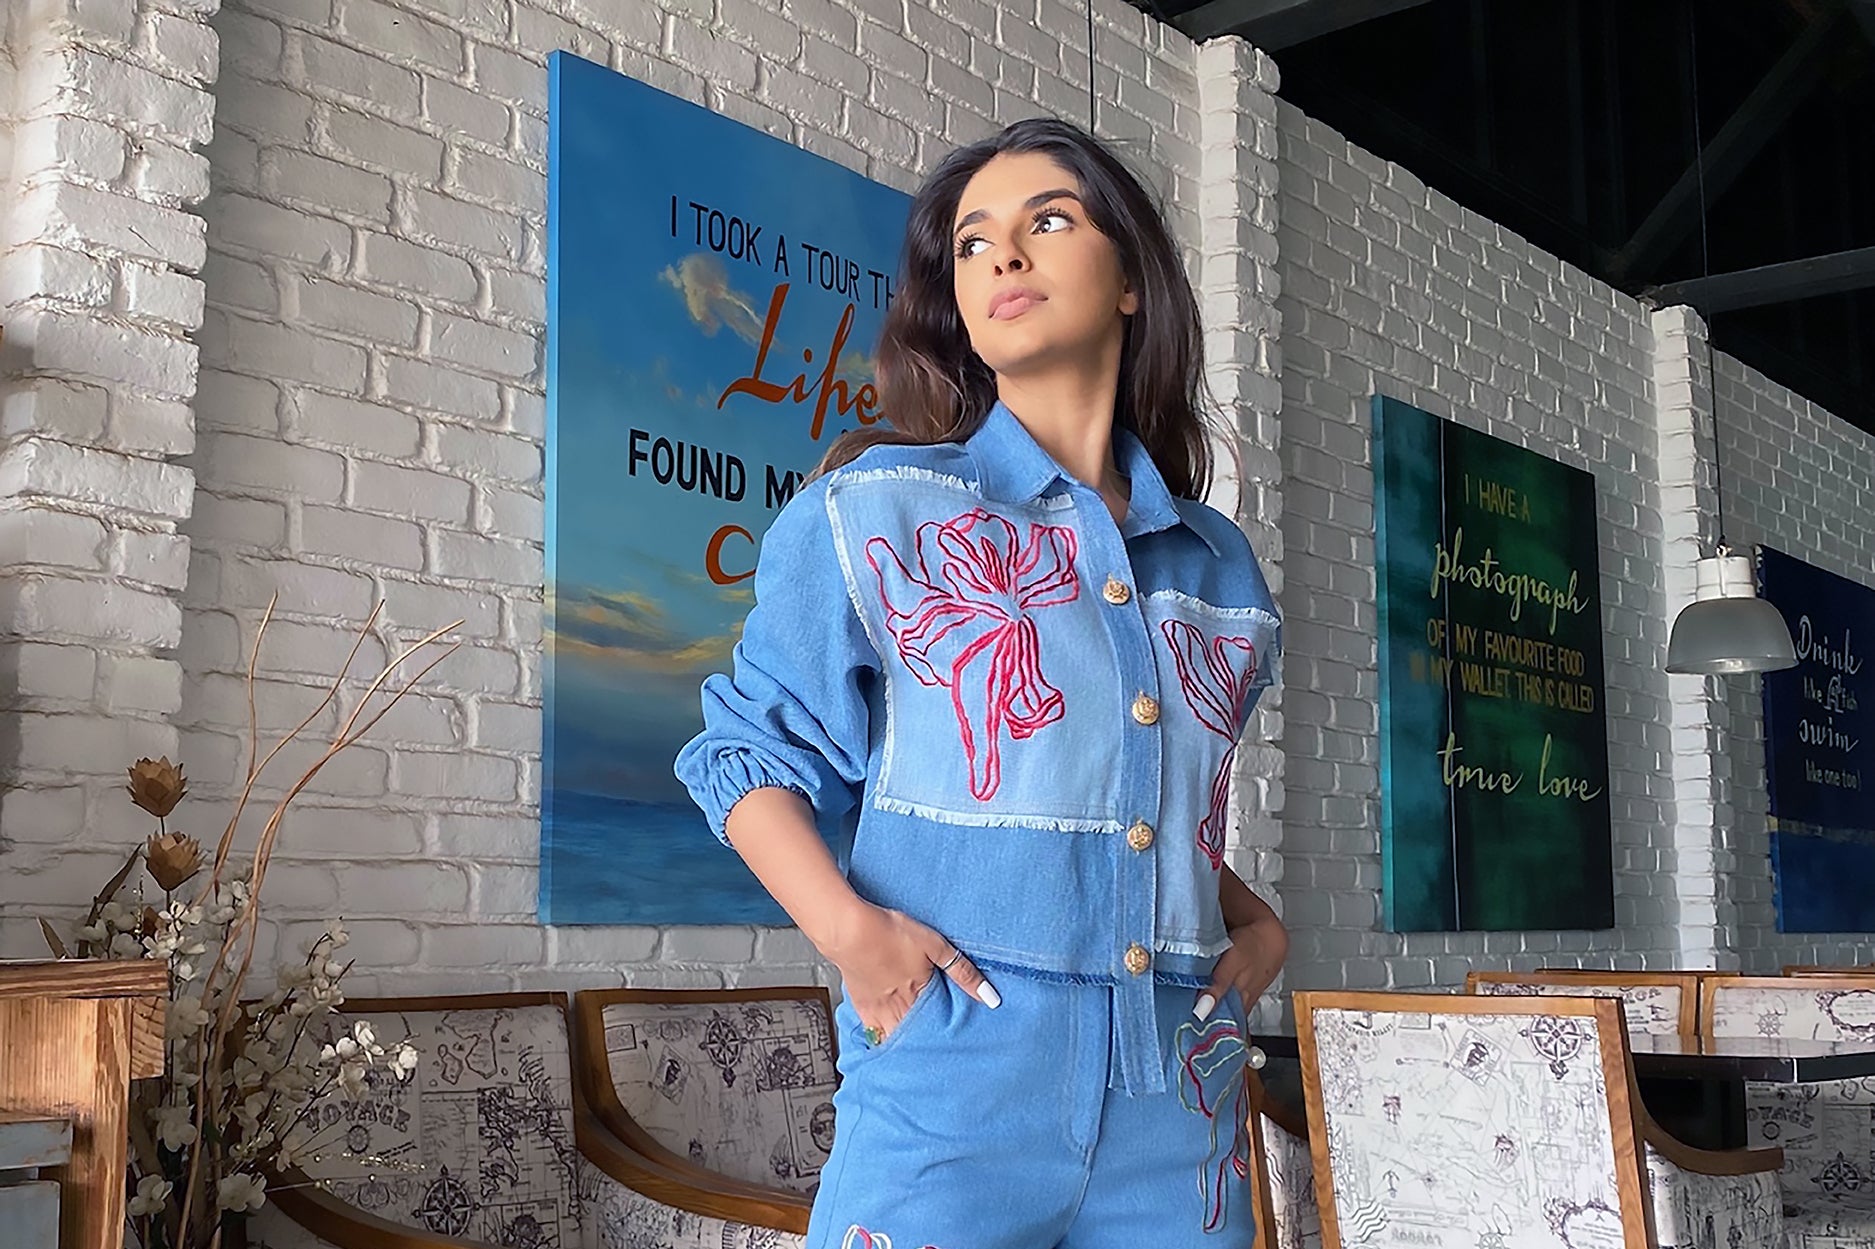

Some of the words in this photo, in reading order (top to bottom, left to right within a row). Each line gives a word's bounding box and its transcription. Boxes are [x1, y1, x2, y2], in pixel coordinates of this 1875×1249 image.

[671, 195, 678, 238] I
[689, 201, 762, 266] TOOK
[773, 234, 789, 277] A
[801, 242, 861, 302] TOUR
[628, 428, 747, 503] FOUND
[765, 464, 807, 510] M
[1465, 473, 1470, 505] I
[1479, 478, 1517, 519] HAVE
[1522, 494, 1532, 524] A
[1430, 526, 1590, 636] photograph
[1427, 618, 1446, 649] OF
[1456, 623, 1478, 656] MY
[1485, 630, 1554, 672] FAVOURITE
[1558, 648, 1585, 677] FOOD
[1797, 615, 1864, 674] Drink
[1516, 671, 1543, 705] THIS
[1545, 680, 1555, 707] IS
[1558, 680, 1595, 714] CALLED
[1436, 731, 1524, 794] true
[1538, 733, 1602, 801] love
